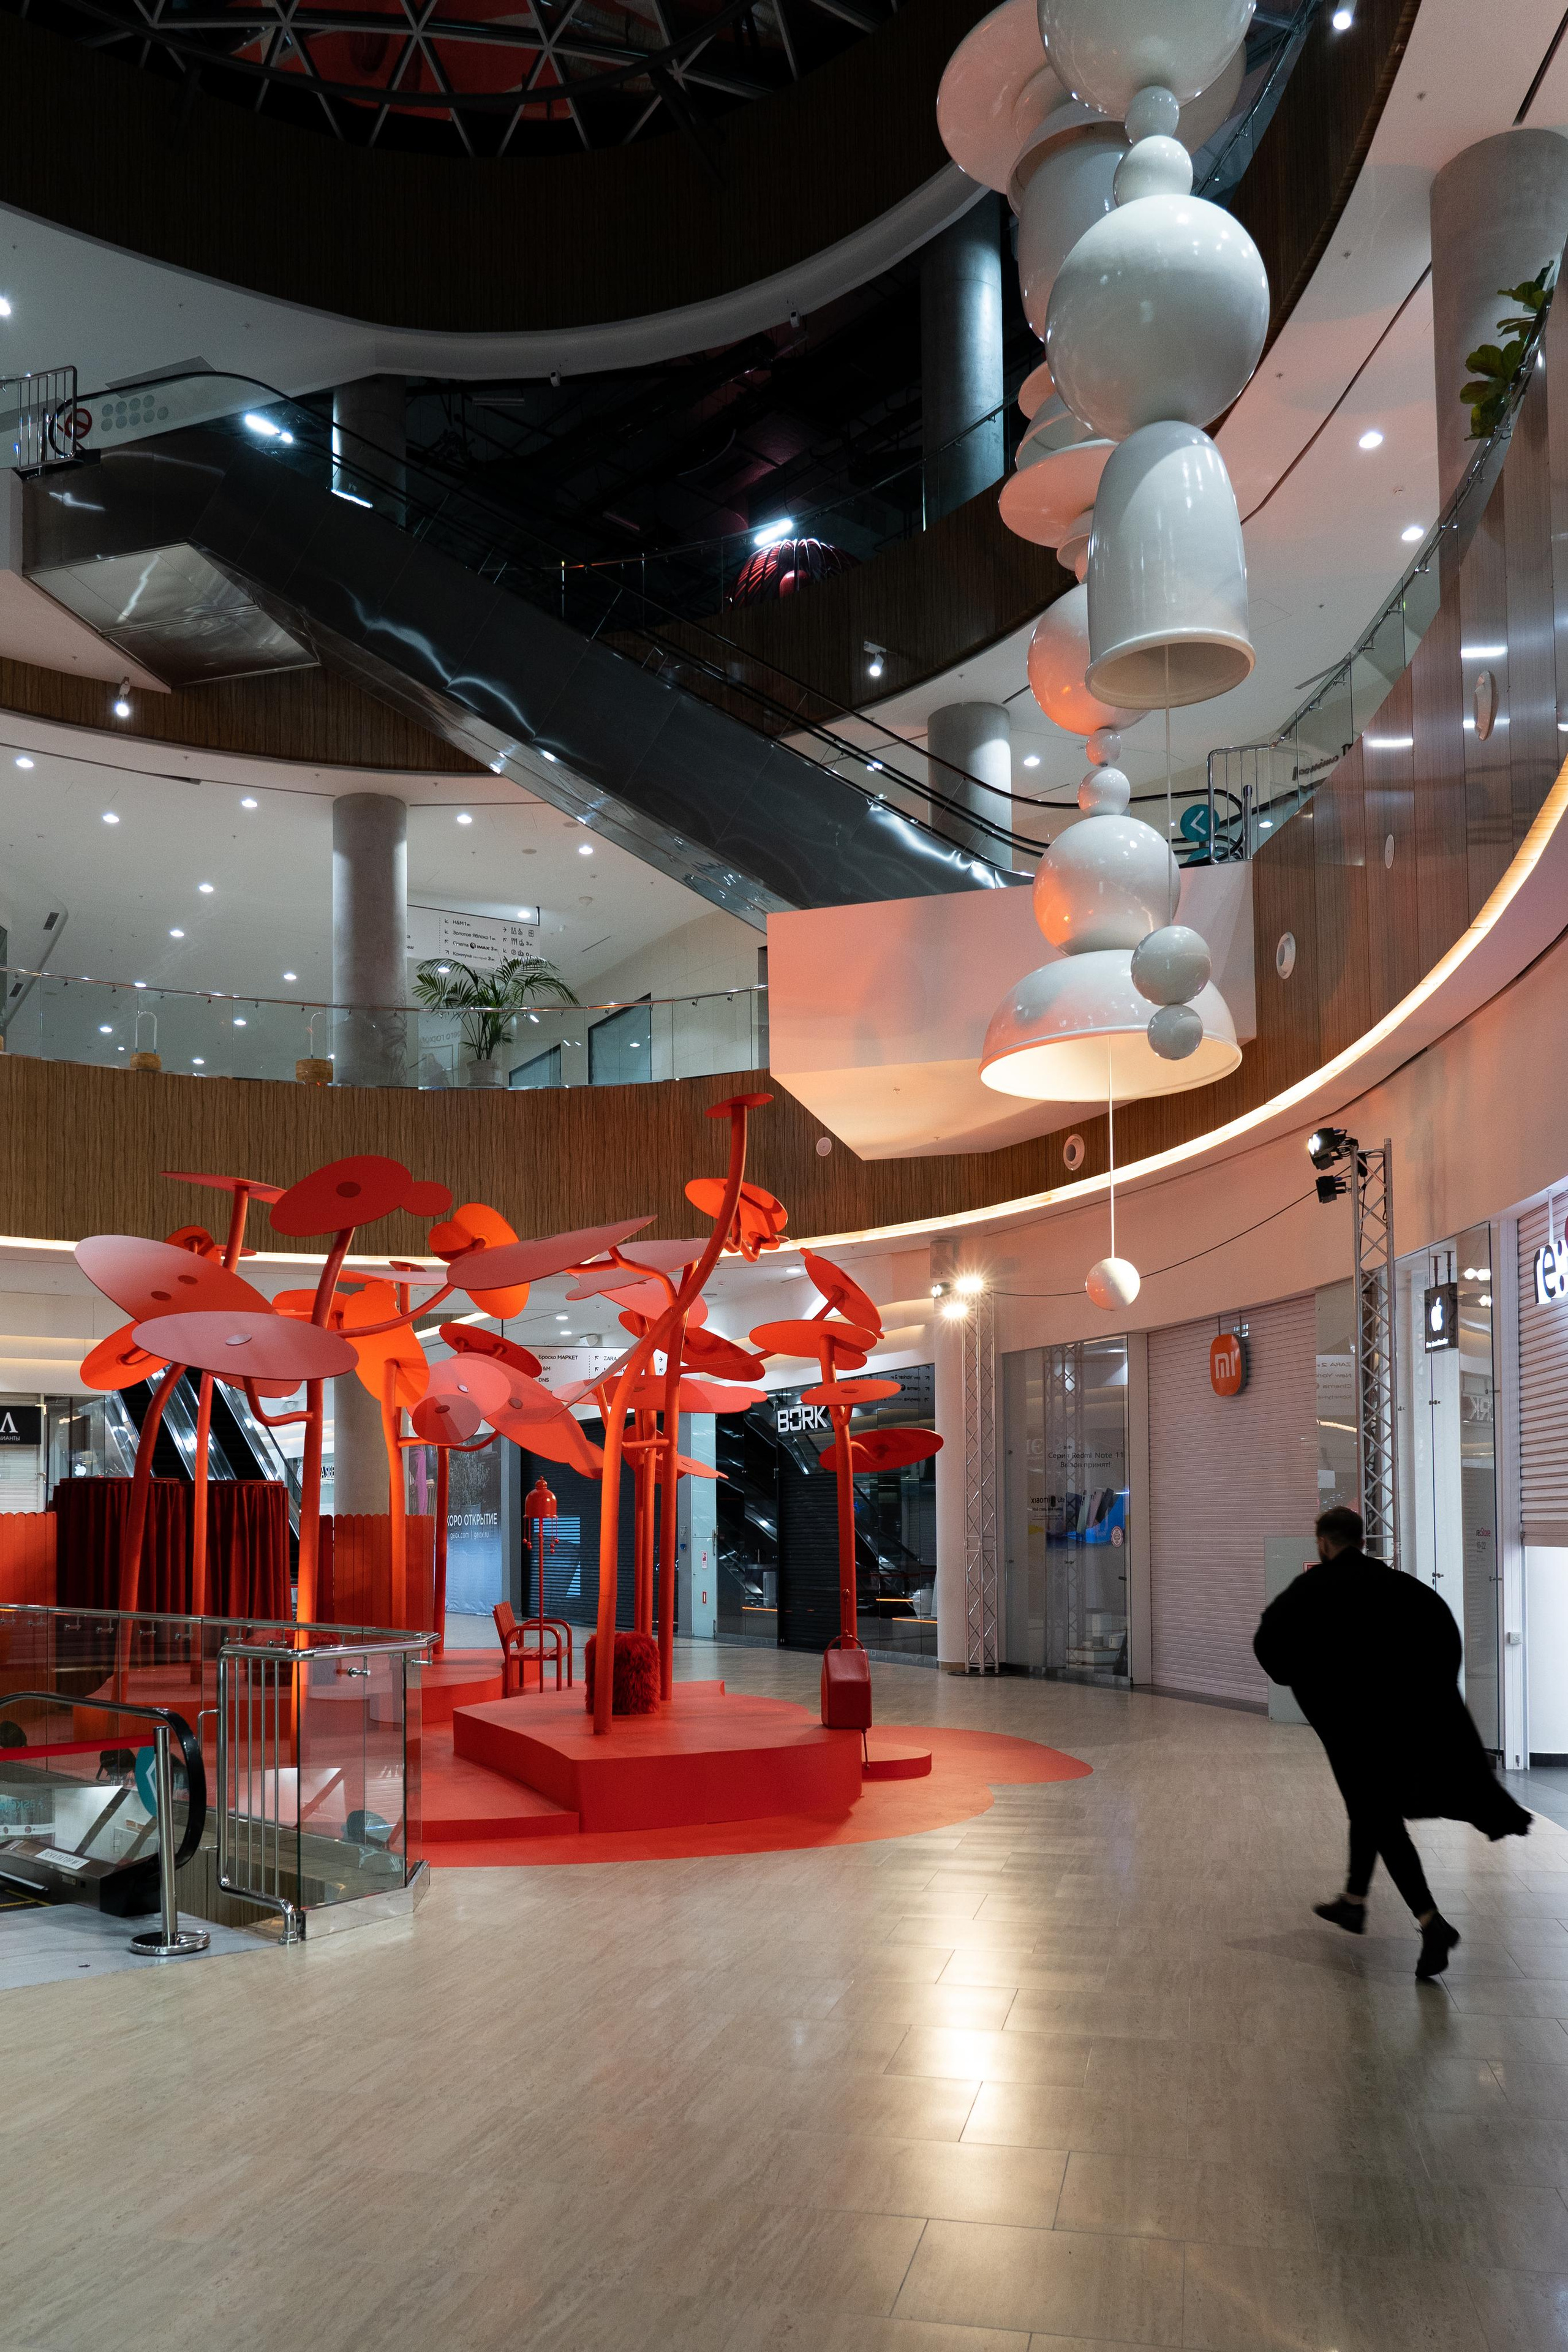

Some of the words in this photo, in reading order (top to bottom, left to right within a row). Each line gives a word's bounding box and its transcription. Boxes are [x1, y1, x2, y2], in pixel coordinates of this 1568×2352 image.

[1534, 1240, 1568, 1305] re:
[777, 1405, 827, 1433] BORK
[447, 1514, 462, 1527] КОРО
[464, 1513, 497, 1526] ОТКРЫТИЕ
[450, 1532, 469, 1540] geox.com
[473, 1531, 489, 1540] geox.ru
